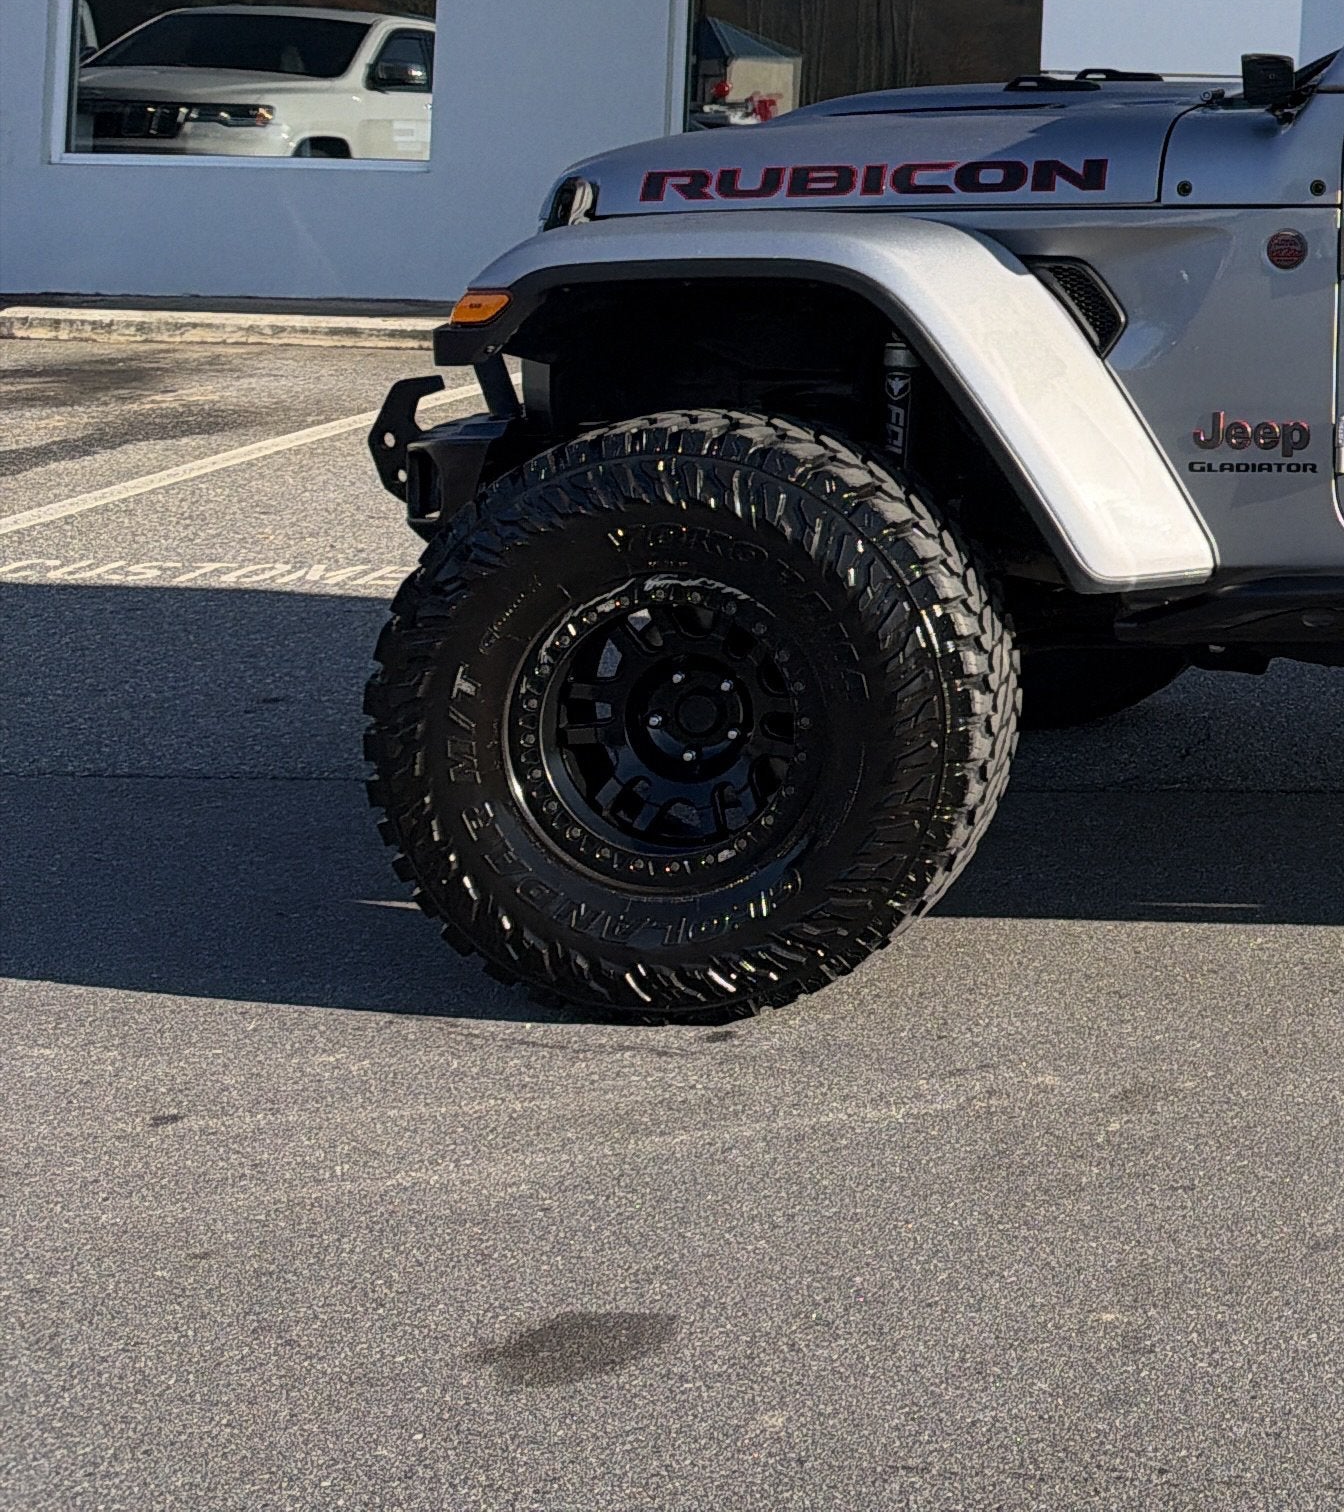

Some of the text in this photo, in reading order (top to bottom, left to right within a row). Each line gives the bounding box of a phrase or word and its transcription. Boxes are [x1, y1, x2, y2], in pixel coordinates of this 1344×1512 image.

[639, 158, 1110, 203] RUBICON
[1192, 411, 1311, 458] Jeep
[1188, 461, 1319, 474] GLADIATOR
[0, 558, 420, 585] CUSTOME
